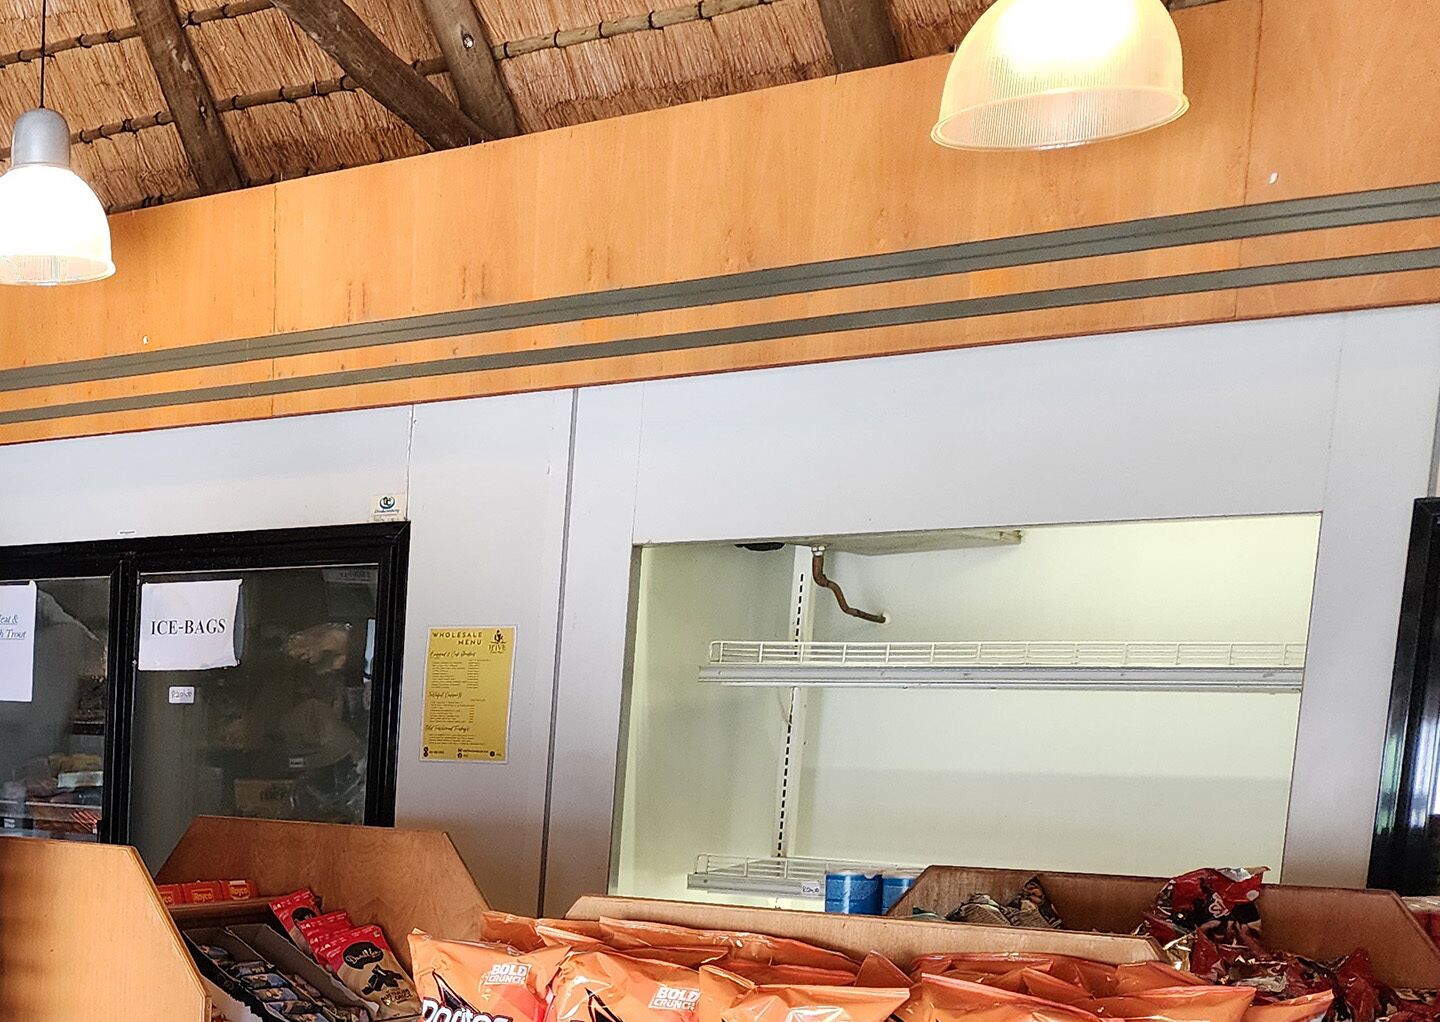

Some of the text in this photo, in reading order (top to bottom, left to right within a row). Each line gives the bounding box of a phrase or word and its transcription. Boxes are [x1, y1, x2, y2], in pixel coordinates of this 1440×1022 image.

[11, 614, 19, 625] &
[151, 618, 226, 636] ICE-BAGS
[6, 629, 27, 639] Trout
[431, 631, 483, 639] WHOLESALE
[491, 964, 529, 976] BOLD
[656, 986, 700, 1003] BOLD
[653, 998, 696, 1011] CRUNCH
